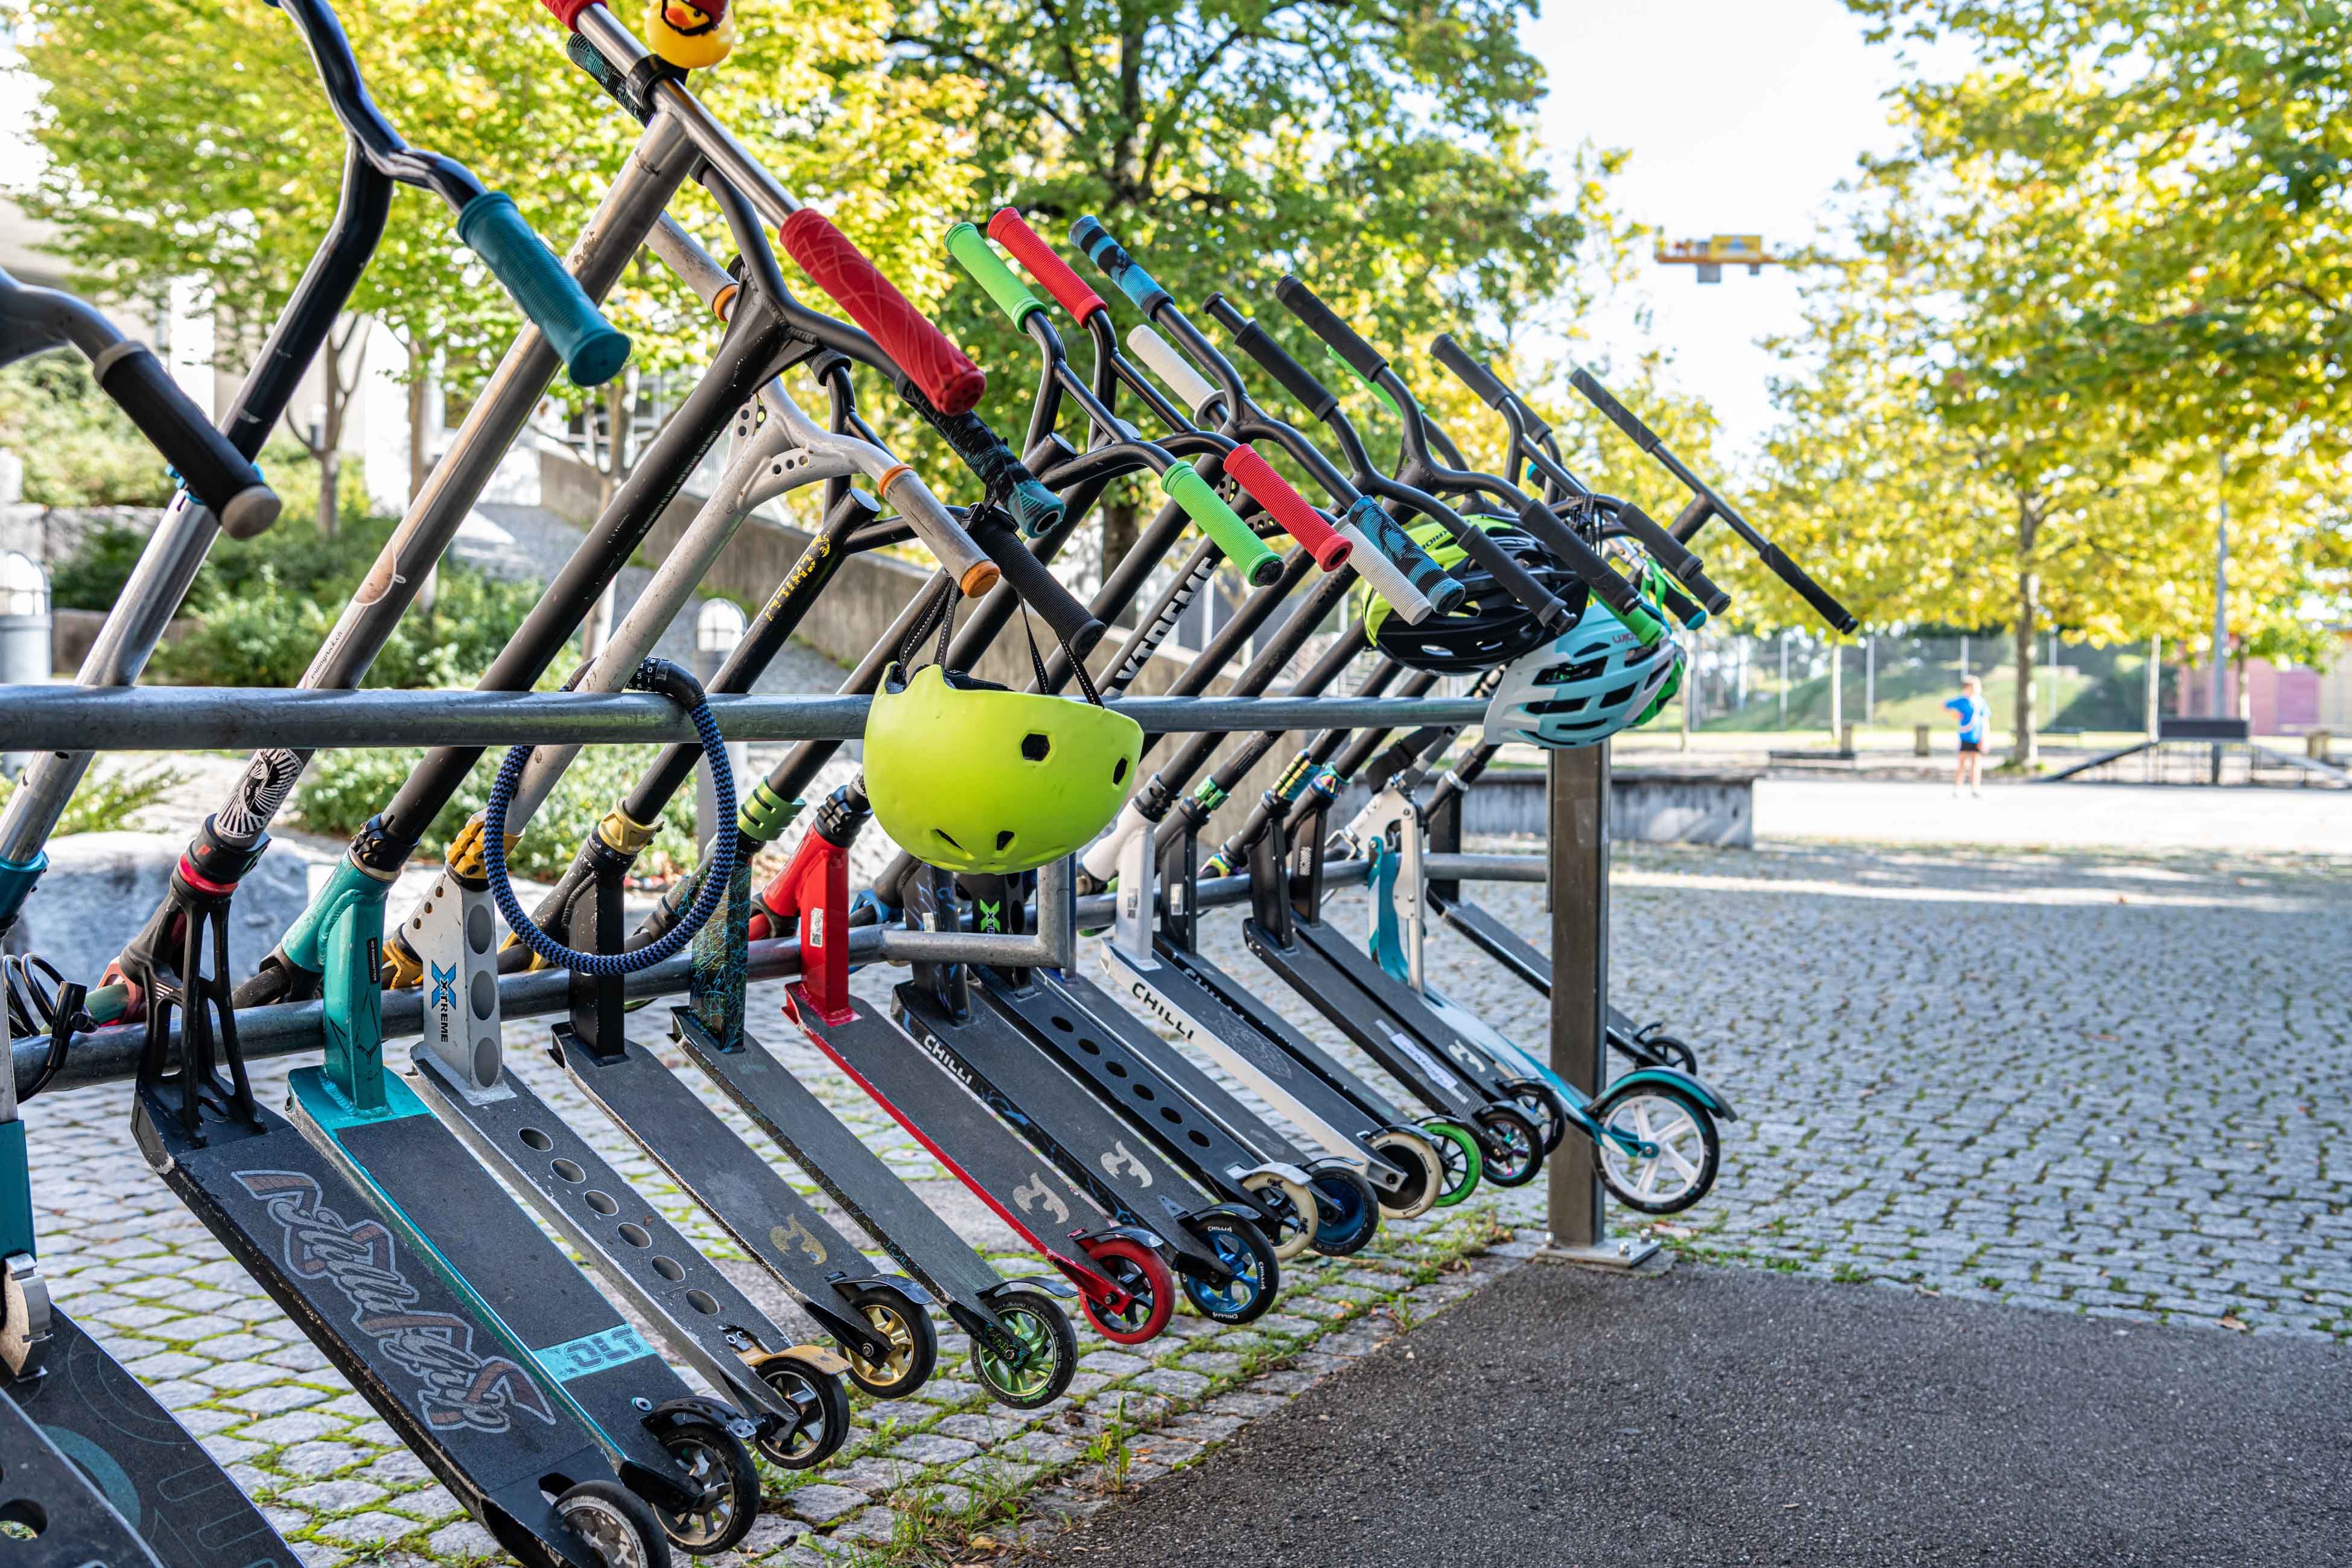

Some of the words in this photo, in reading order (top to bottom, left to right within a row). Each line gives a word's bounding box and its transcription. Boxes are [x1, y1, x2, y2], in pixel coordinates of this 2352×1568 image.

[440, 978, 448, 1043] XTREME
[1133, 982, 1194, 1040] CHILLI
[924, 1034, 973, 1085] CHILLI
[546, 1327, 644, 1375] OLT
